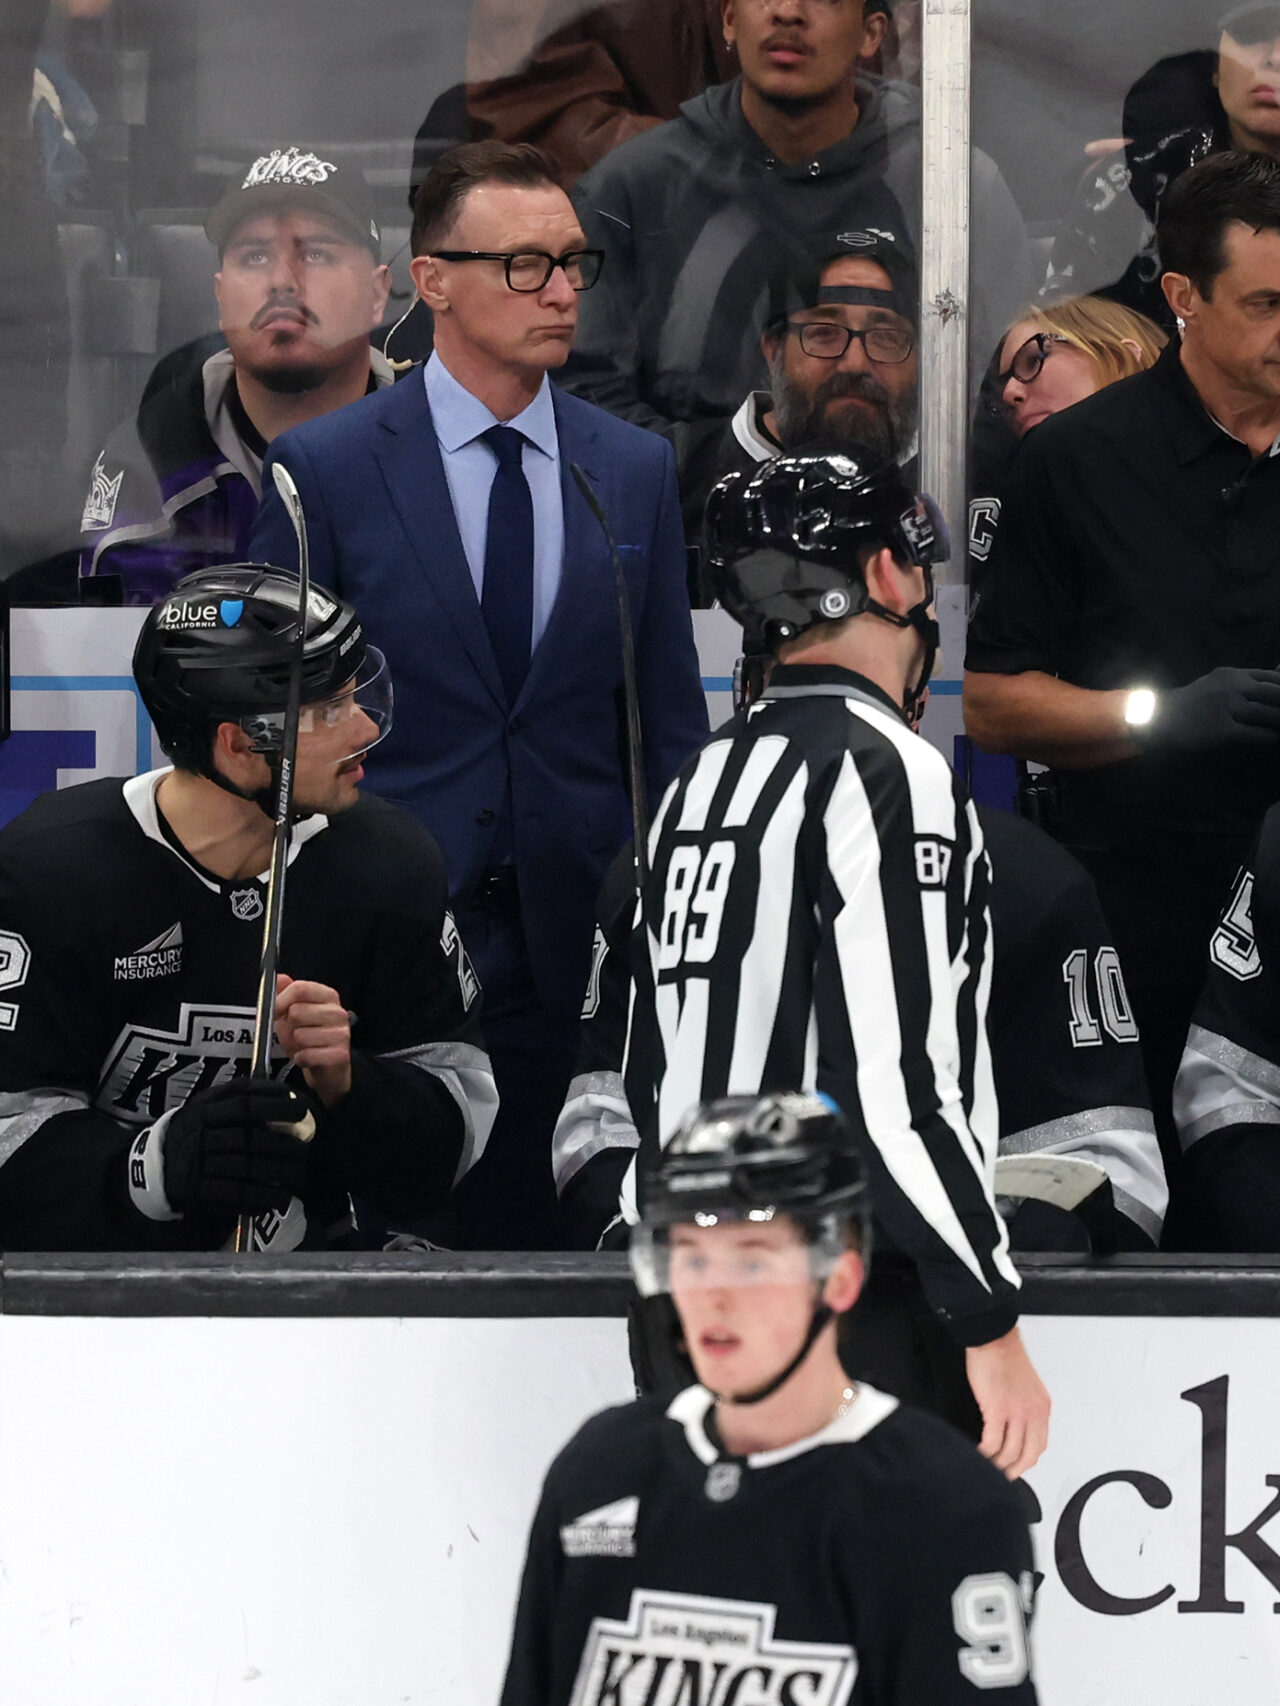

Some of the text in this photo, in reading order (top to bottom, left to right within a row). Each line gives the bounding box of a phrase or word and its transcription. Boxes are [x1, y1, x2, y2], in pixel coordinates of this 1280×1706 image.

[241, 154, 338, 190] KINGS
[165, 602, 218, 622] blue
[164, 621, 217, 631] CALIFORNIA
[659, 840, 736, 970] 89
[114, 947, 183, 970] MERCURY
[114, 960, 182, 980] INSURANCE
[1062, 946, 1140, 1048] 10
[202, 1026, 234, 1044] Los
